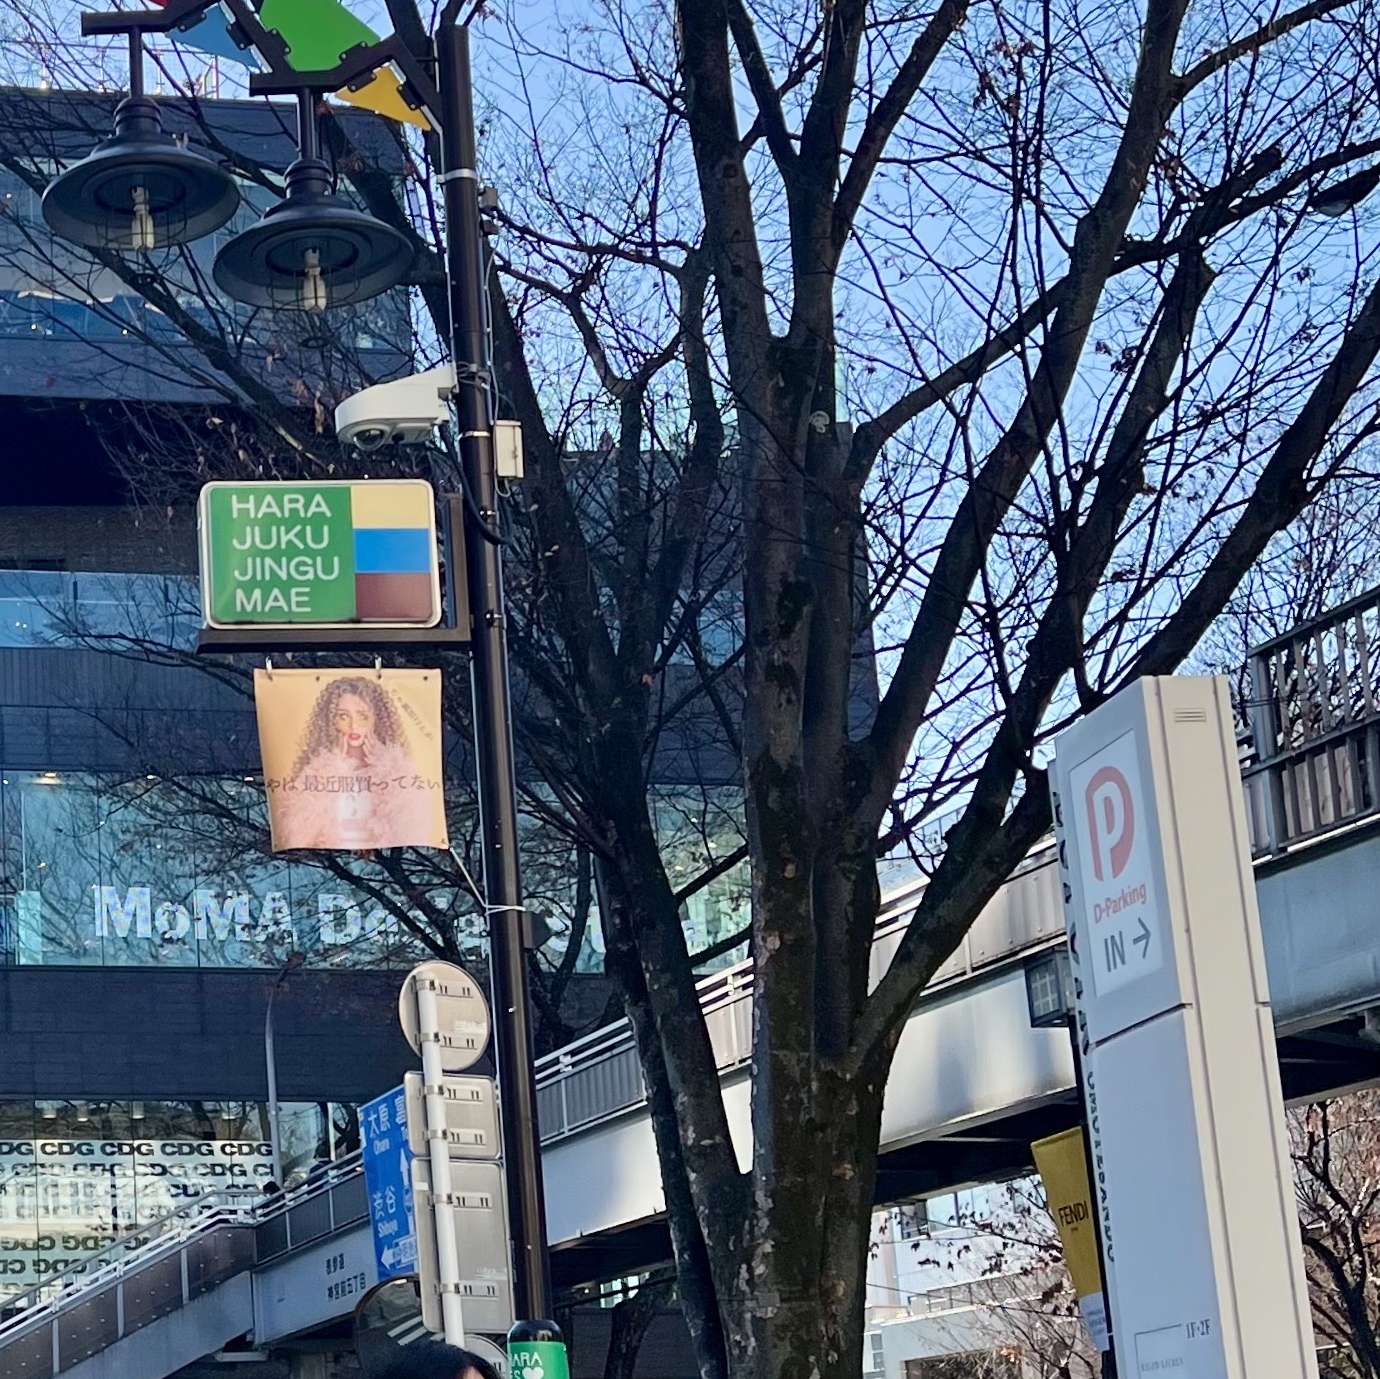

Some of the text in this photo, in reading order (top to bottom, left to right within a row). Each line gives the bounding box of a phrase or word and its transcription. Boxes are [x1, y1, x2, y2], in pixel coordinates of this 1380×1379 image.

[231, 494, 332, 519] HARA
[232, 525, 330, 550] JUKU
[233, 556, 340, 581] JINGU
[235, 587, 312, 613] MAE
[94, 885, 297, 942] MoMA
[1093, 882, 1147, 925] D-Parking
[1104, 930, 1126, 973] IN
[40, 1142, 95, 1156] CDG
[100, 1142, 154, 1157] CDG
[160, 1143, 215, 1157] CDG
[220, 1143, 273, 1157] CDG
[1058, 1199, 1089, 1227] FENDI
